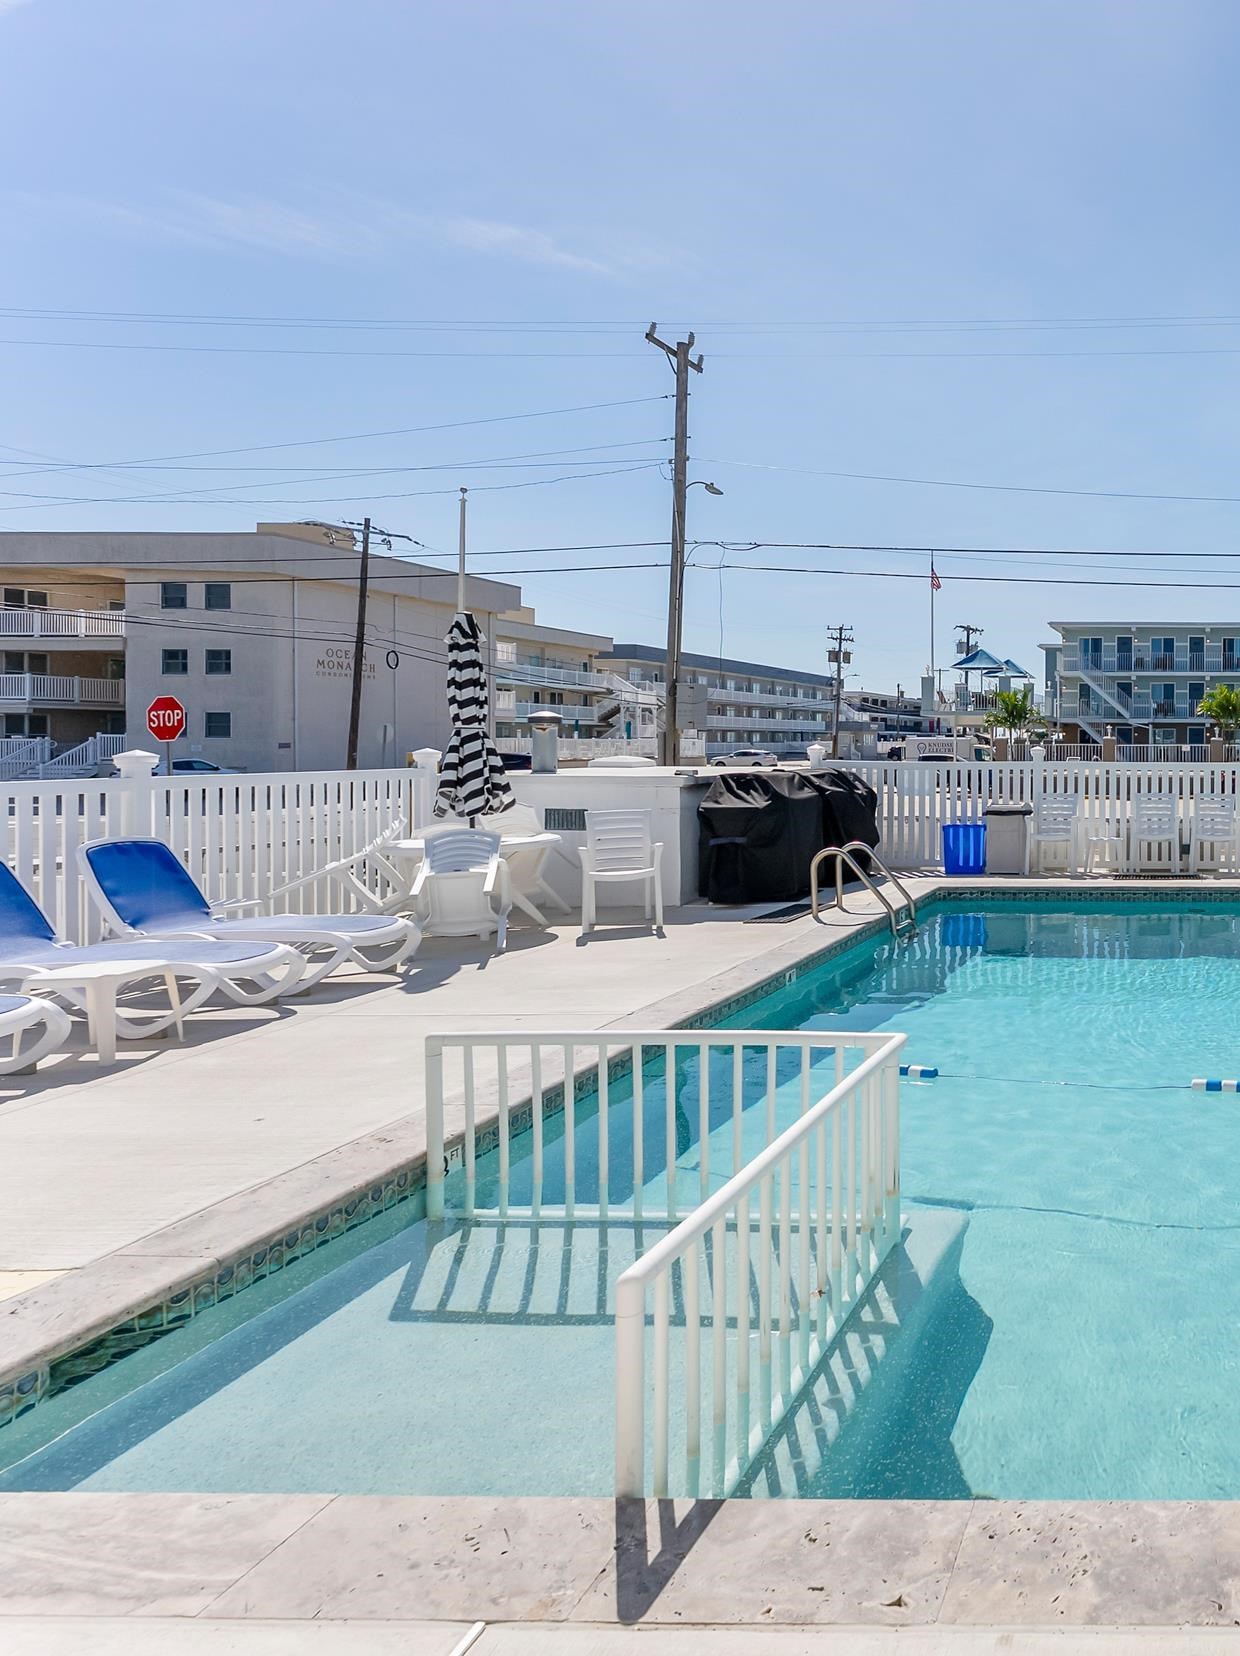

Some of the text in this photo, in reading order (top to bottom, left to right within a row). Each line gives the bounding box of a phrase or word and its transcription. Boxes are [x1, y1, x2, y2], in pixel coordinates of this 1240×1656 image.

[326, 648, 367, 661] OCEN
[316, 660, 376, 674] MONACH
[150, 710, 182, 727] STOP
[450, 1147, 460, 1161] FT
